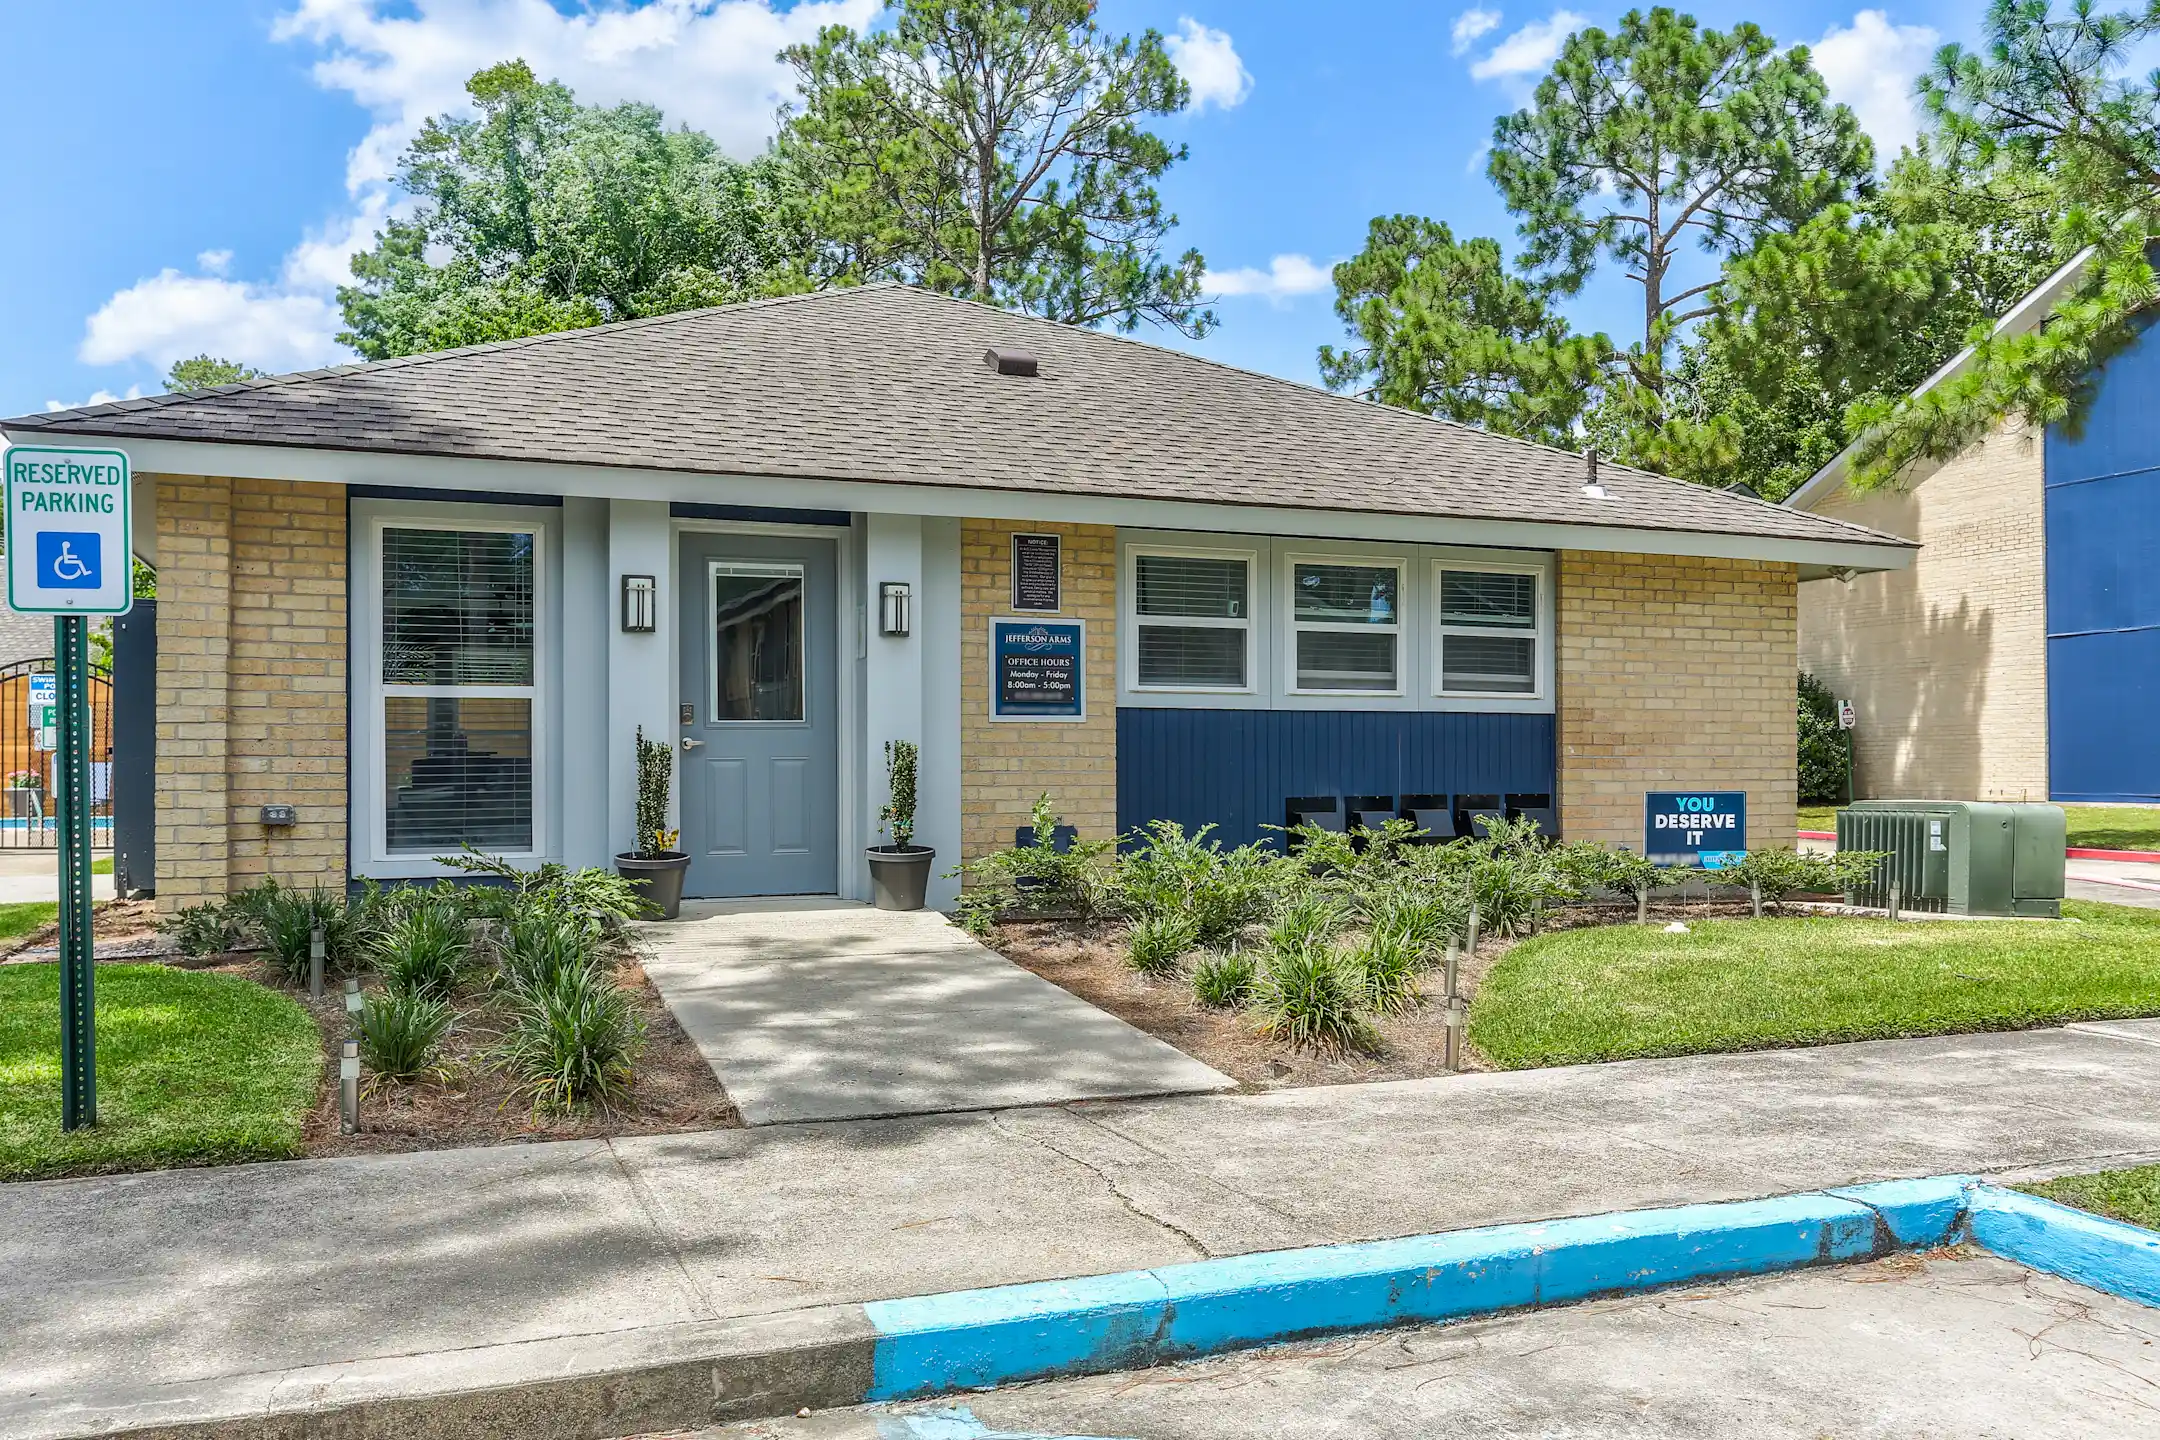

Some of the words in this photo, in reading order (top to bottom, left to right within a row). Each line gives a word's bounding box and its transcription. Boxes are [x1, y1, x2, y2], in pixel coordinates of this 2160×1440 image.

[14, 462, 120, 486] RESERVED
[22, 491, 114, 514] PARKING
[1005, 634, 1047, 643] JEFFERSON
[1049, 635, 1072, 644] ARMS
[1008, 658, 1038, 666] OFFICE
[1041, 658, 1070, 667] HOURS
[1010, 670, 1039, 679] Monday
[1046, 670, 1068, 680] Friday
[1007, 681, 1036, 689] 8:00am
[1043, 681, 1071, 690] 5:00pm
[36, 692, 56, 700] CLO
[1676, 797, 1715, 812] YOU
[1655, 813, 1736, 829] DESERVE
[1686, 831, 1704, 846] IT
